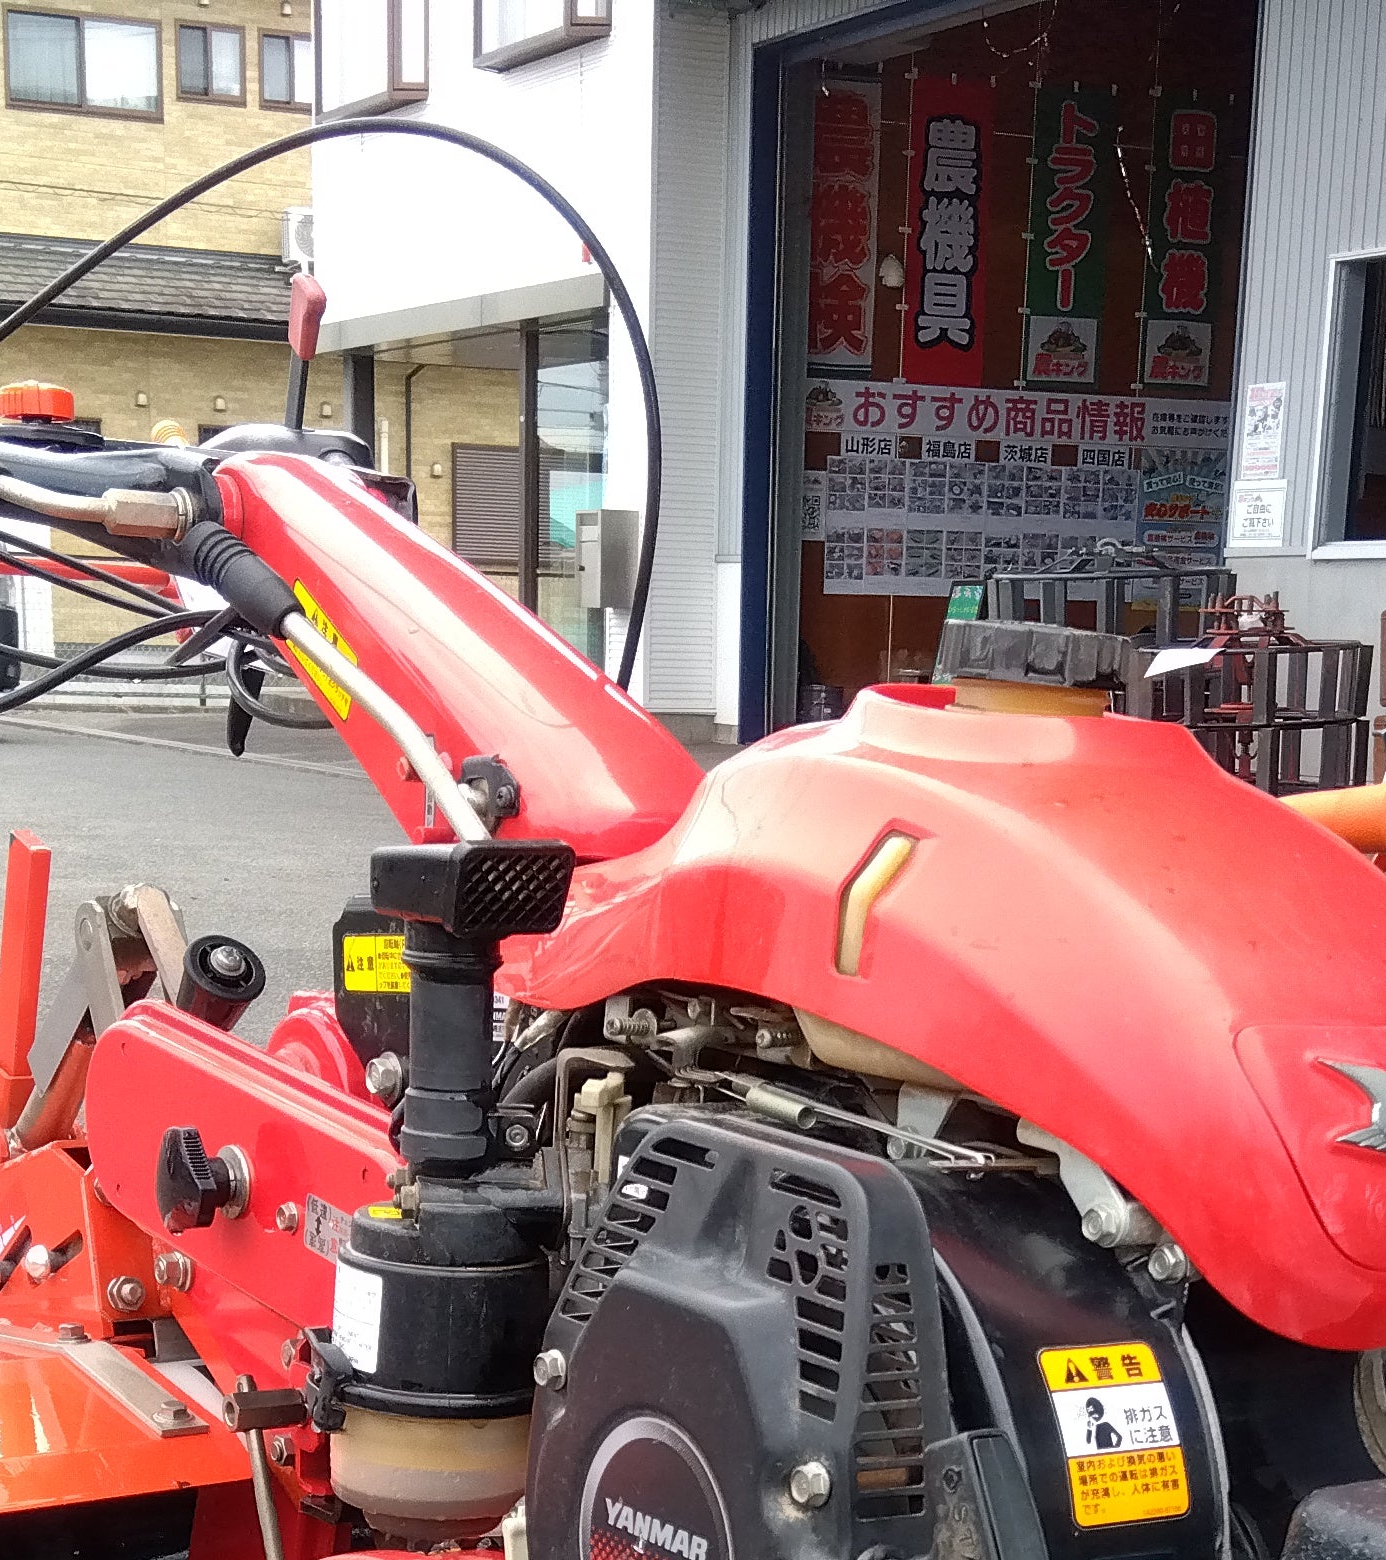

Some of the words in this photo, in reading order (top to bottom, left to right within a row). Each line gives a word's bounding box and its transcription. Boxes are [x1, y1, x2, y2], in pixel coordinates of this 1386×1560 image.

[1044, 100, 1098, 311] トラクター
[1160, 109, 1217, 314] 田植機
[916, 117, 979, 347] 農機具
[853, 386, 1146, 442] おすすめ商品情報
[845, 437, 892, 456] 山形店
[926, 440, 972, 460] 福島店
[1003, 444, 1049, 464] 茨城店
[1081, 450, 1126, 467] 四国店
[356, 956, 375, 972] 注意
[1090, 1353, 1144, 1381] 警告
[1124, 1404, 1168, 1425] 排ガス
[1129, 1424, 1174, 1445] に注意
[1076, 1451, 1177, 1473] 室内および換気の悪い
[1078, 1464, 1178, 1487] 場所での運転は排ガス
